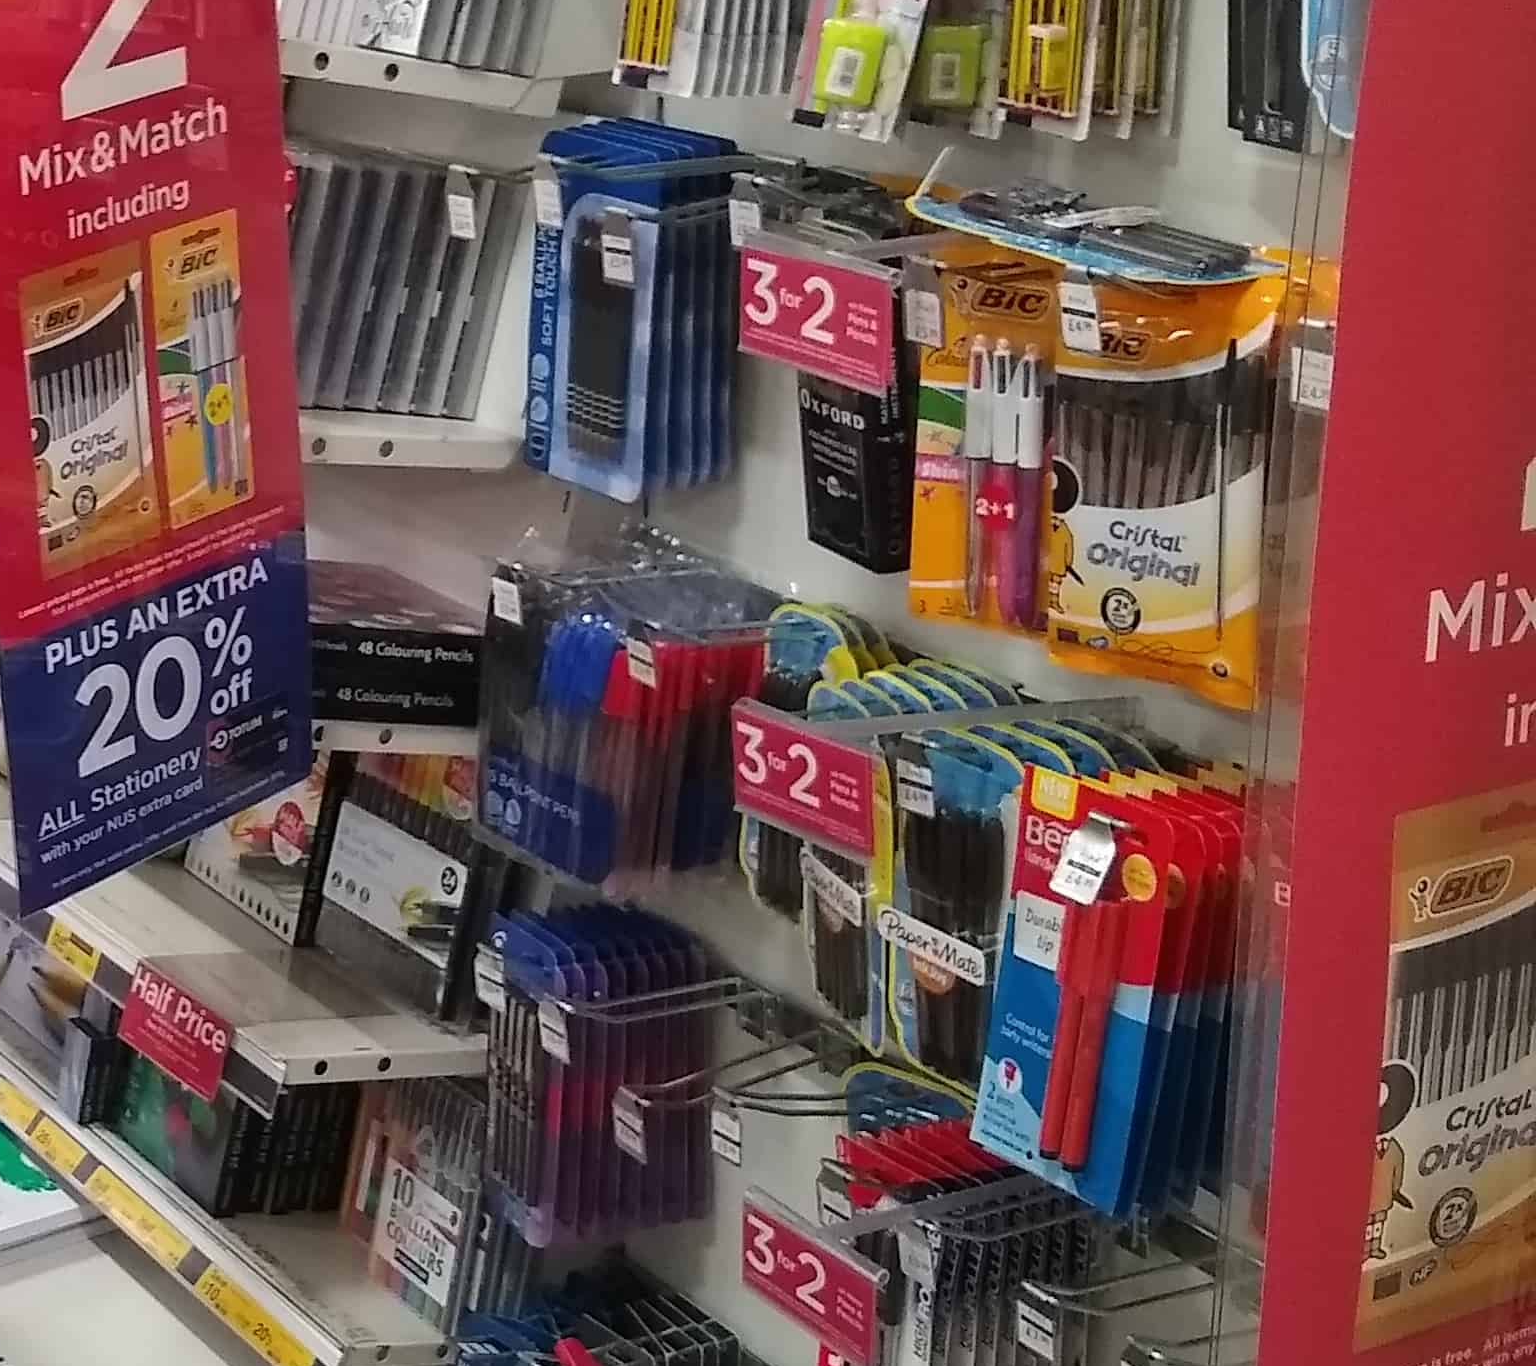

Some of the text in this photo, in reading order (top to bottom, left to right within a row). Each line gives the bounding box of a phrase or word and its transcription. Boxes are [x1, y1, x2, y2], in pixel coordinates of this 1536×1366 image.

[68, 178, 191, 240] including
[745, 258, 834, 344] 3 for 2
[800, 388, 865, 430] OXFORD
[1086, 542, 1199, 587] Original
[46, 619, 119, 674] PLUS
[126, 598, 169, 639] AN
[175, 558, 269, 619] EXTRA
[358, 641, 373, 655] 48
[376, 642, 432, 663] Colouring
[435, 644, 474, 662] Pencils
[210, 668, 253, 715] off
[337, 687, 352, 701] 48
[355, 688, 410, 708] Colouring
[38, 800, 86, 839] ALL
[91, 746, 201, 812] Stationery
[736, 721, 766, 784] 3
[767, 752, 786, 772] for
[788, 743, 820, 809] 2
[40, 777, 204, 864] with your NUS extra card
[131, 966, 226, 1053] Half Price
[393, 1169, 414, 1208] 10
[746, 1214, 775, 1275] 3
[776, 1249, 796, 1272] for
[796, 1252, 825, 1314] 2
